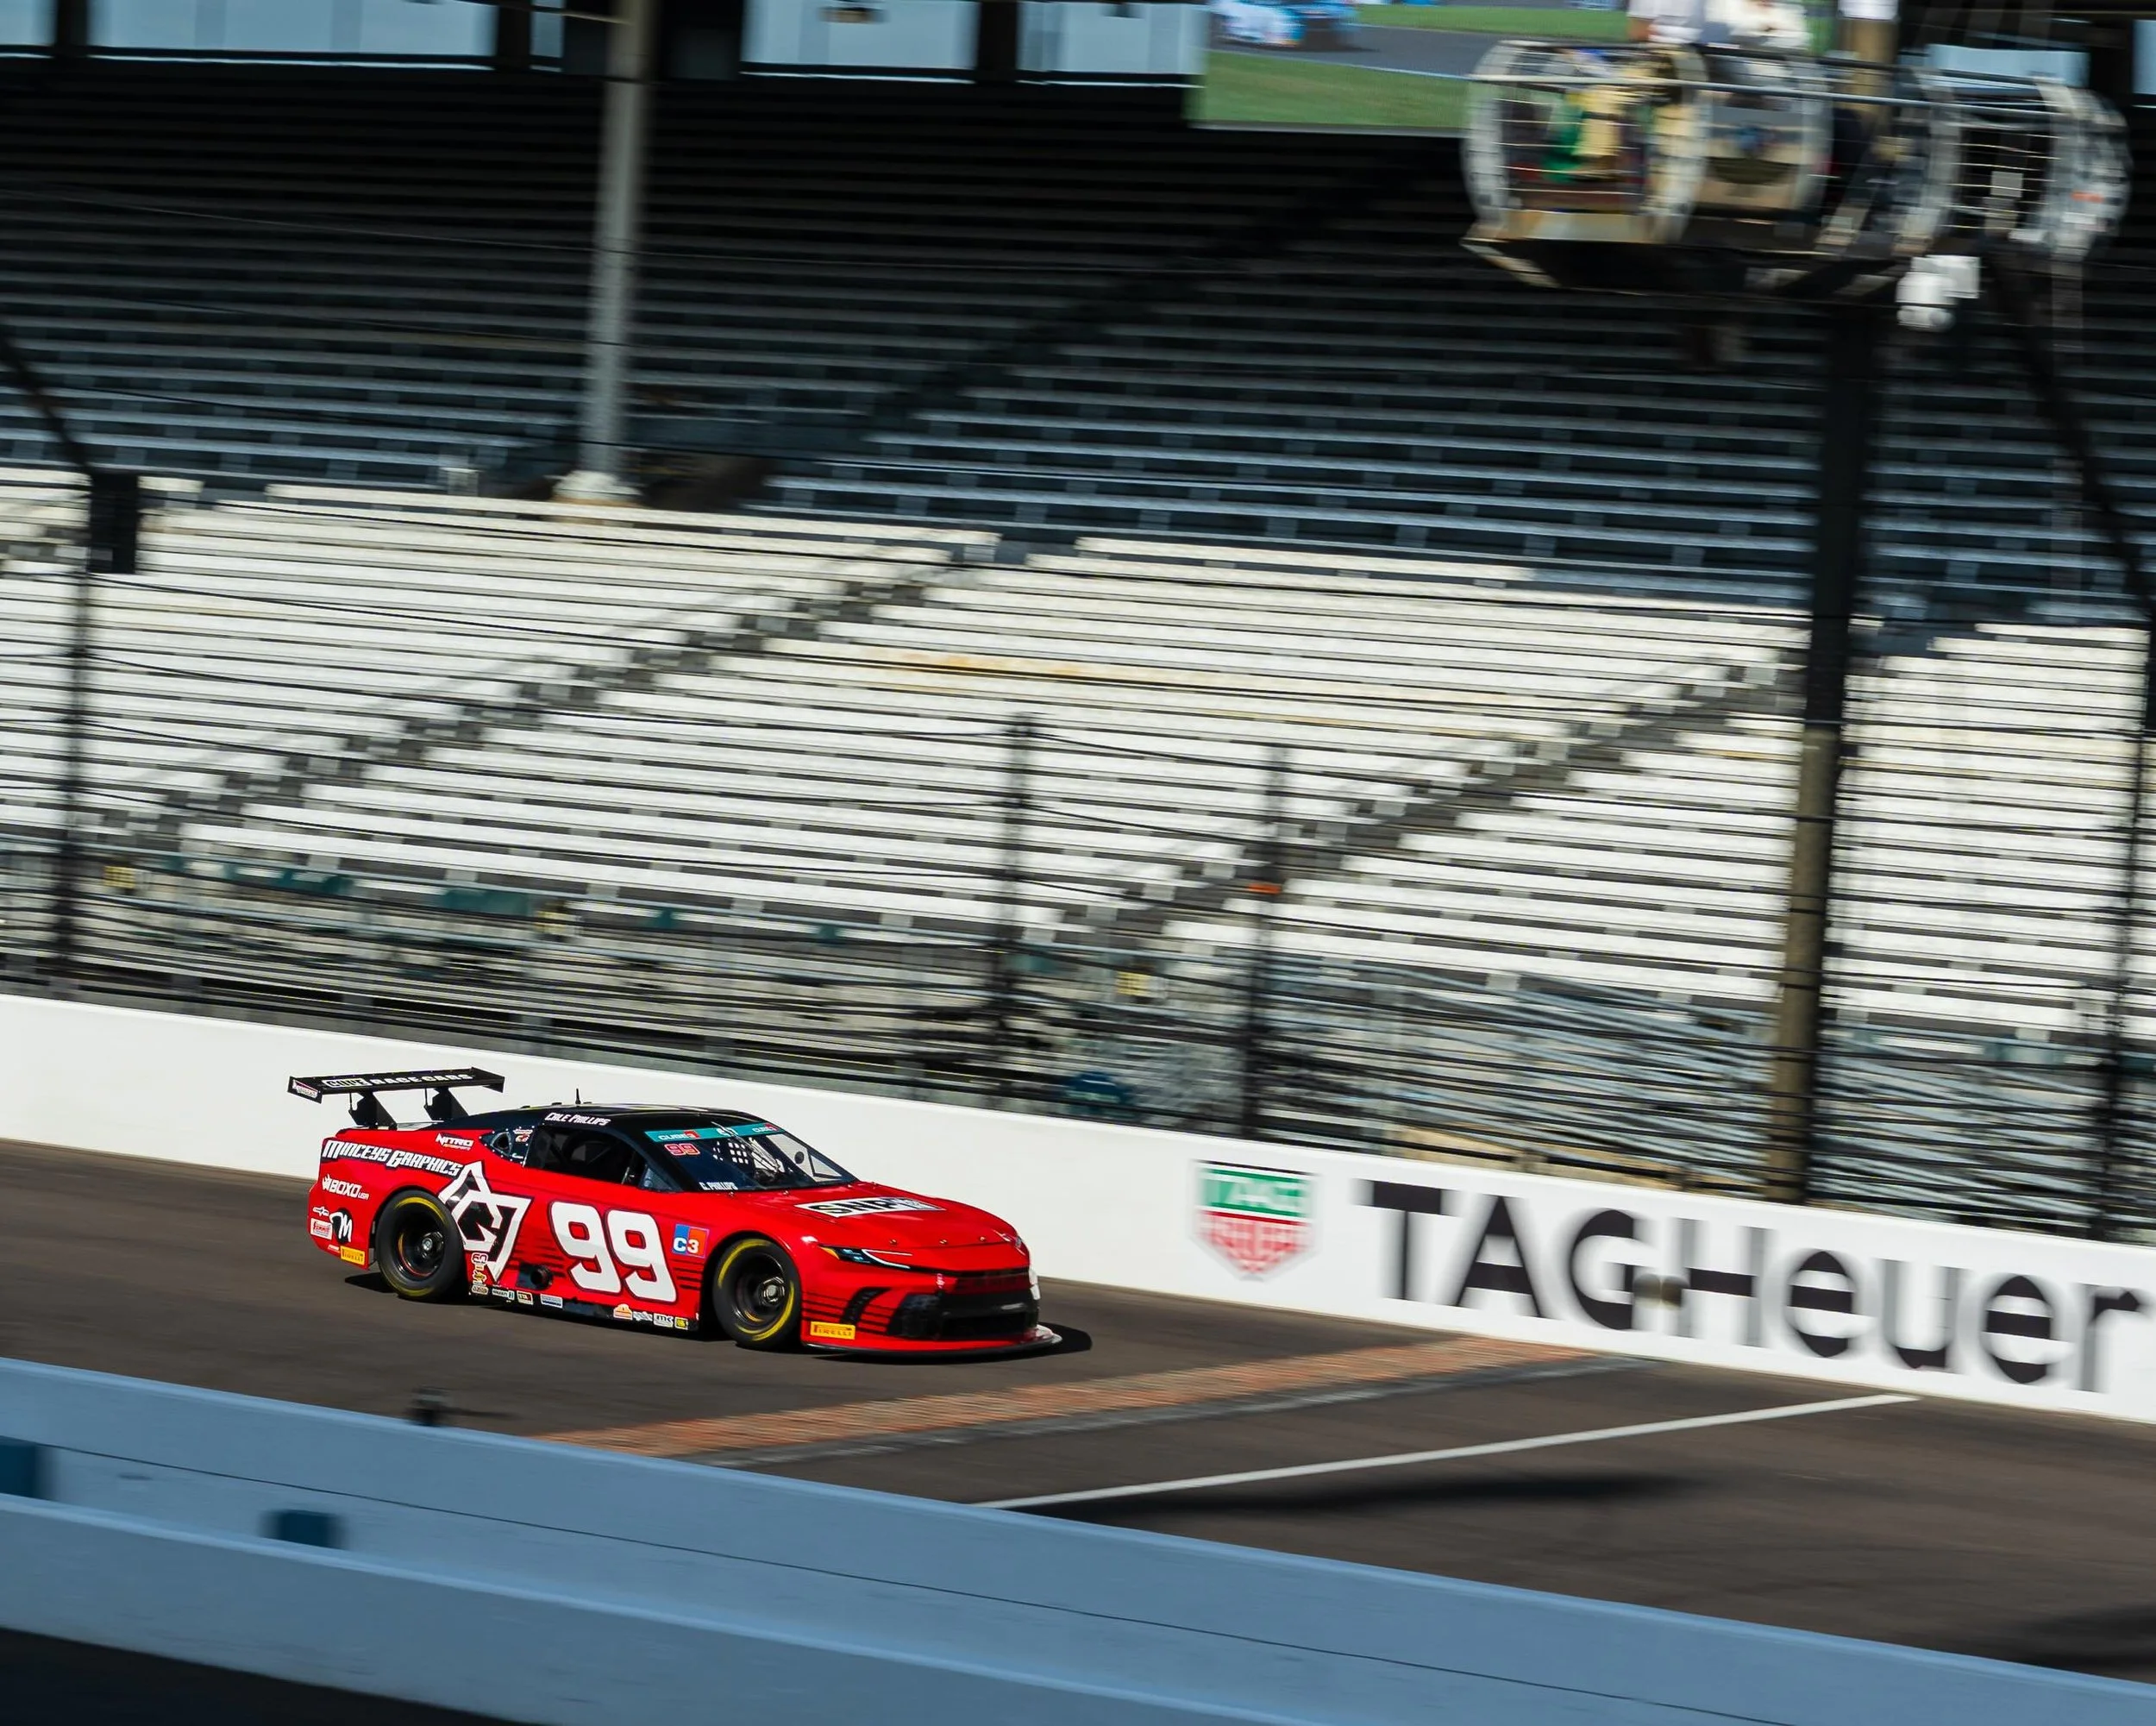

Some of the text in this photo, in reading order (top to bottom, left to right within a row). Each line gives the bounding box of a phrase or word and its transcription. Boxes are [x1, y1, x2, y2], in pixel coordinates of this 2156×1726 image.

[435, 1133, 473, 1146] NITRO
[664, 1143, 700, 1156] 99
[387, 1150, 464, 1176] GRAPHICS
[329, 1179, 362, 1198] BOXO
[550, 1200, 678, 1302] 99
[673, 1236, 699, 1253] C3
[813, 1324, 853, 1336] PIRELLI
